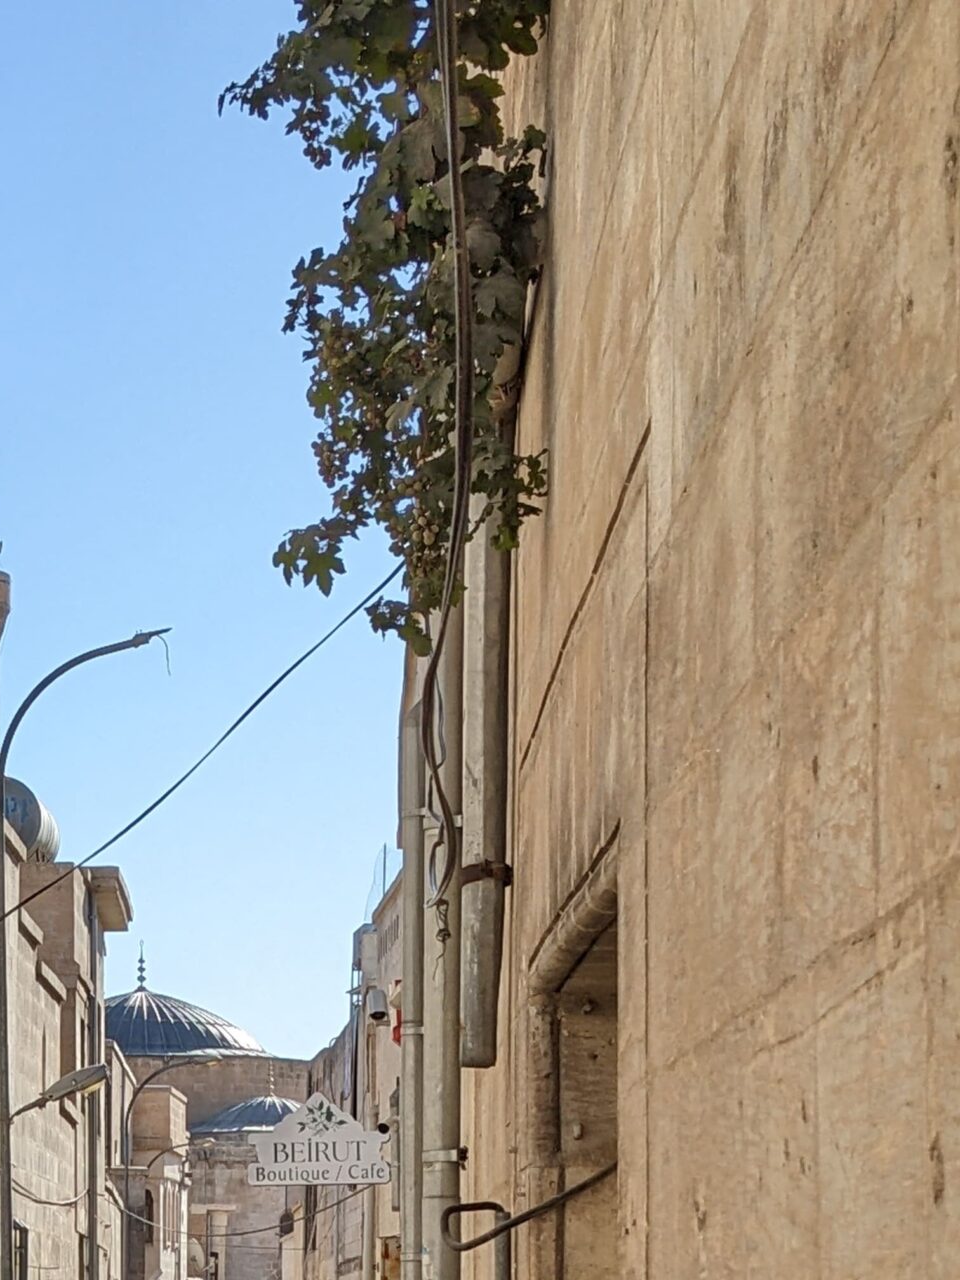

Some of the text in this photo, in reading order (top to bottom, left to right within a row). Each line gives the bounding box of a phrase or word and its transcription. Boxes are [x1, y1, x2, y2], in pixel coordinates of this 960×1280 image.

[273, 1138, 367, 1163] BEİRUT
[256, 1163, 385, 1183] Boutique / Cafe
